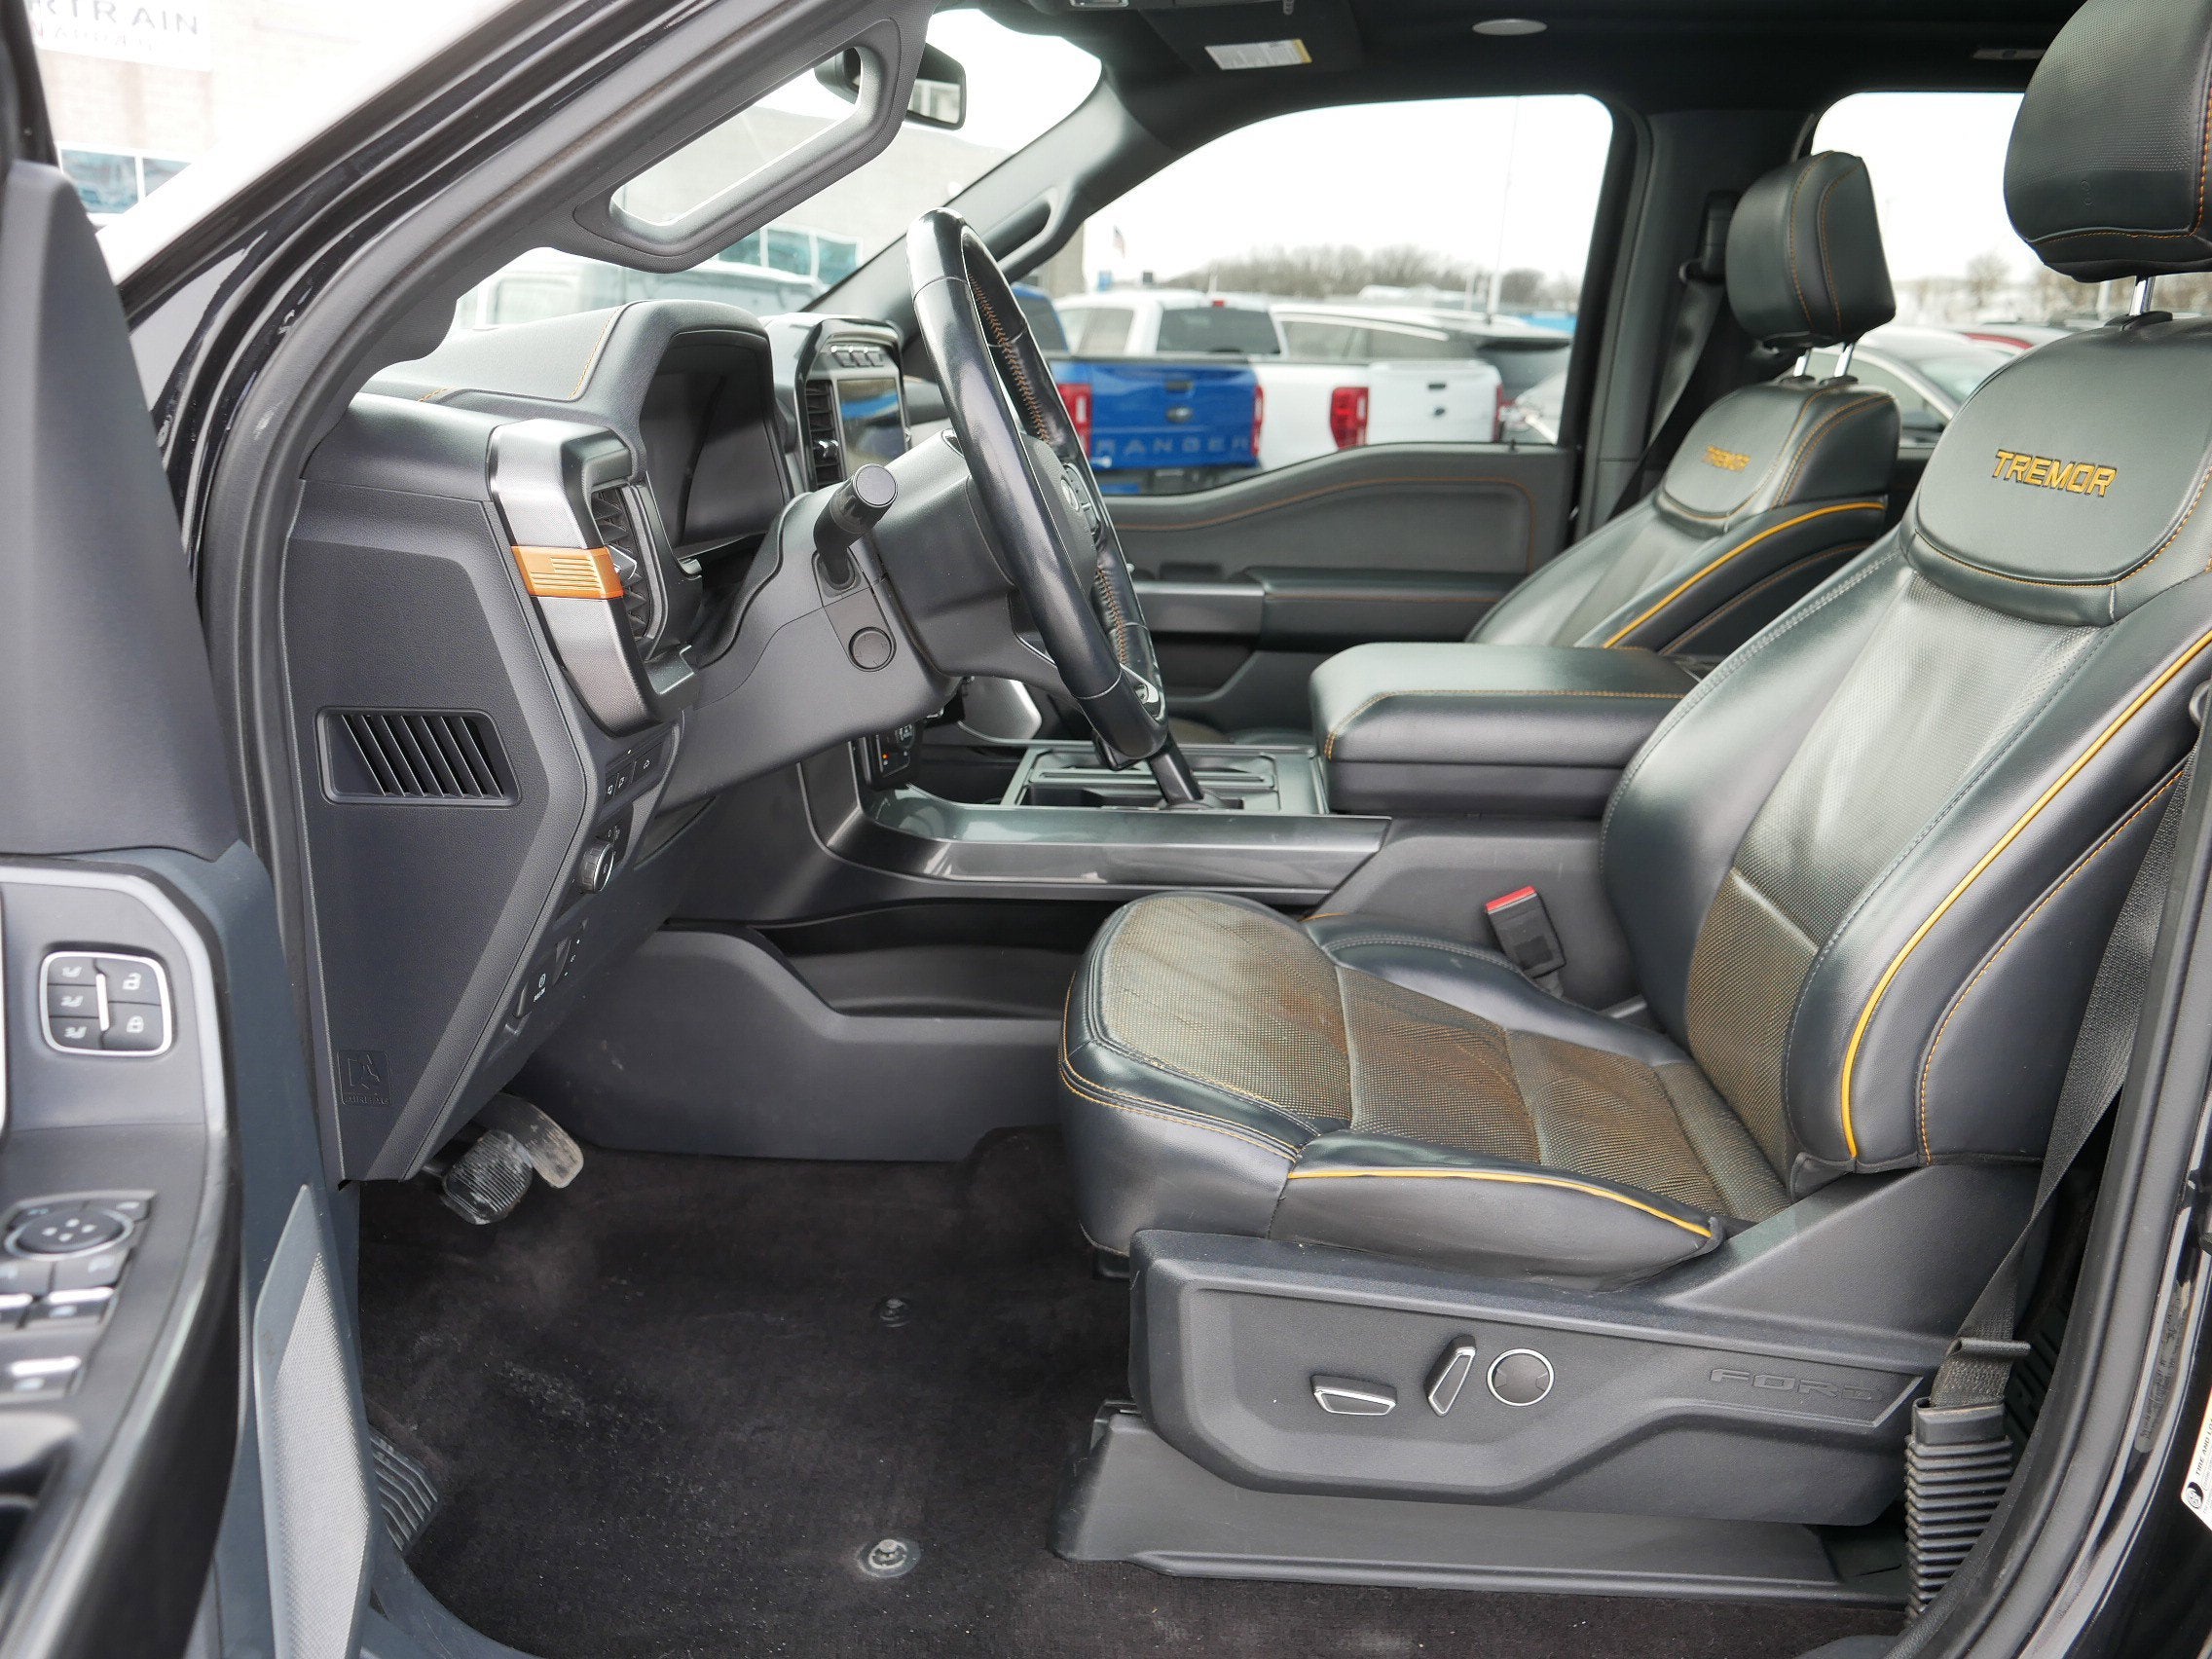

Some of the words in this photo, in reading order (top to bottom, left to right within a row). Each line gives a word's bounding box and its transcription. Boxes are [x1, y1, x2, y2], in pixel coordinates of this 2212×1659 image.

[1096, 438, 1248, 455] RANGER
[1992, 449, 2118, 498] TREMOR
[1710, 1368, 1881, 1400] FORD
